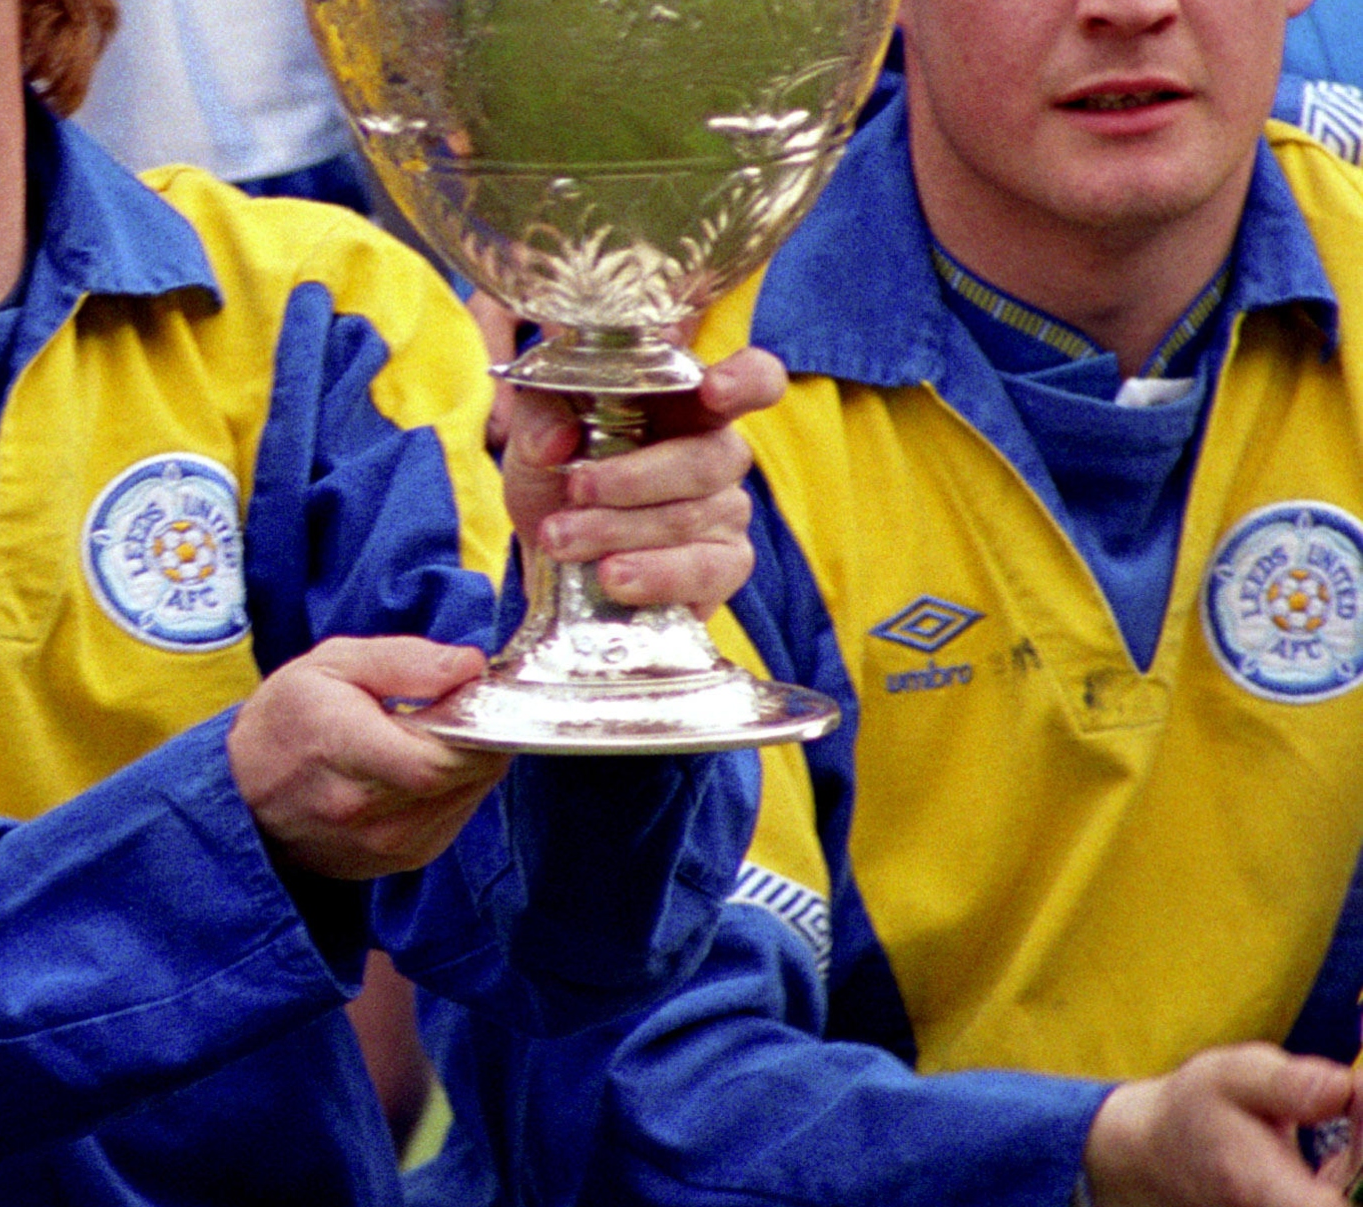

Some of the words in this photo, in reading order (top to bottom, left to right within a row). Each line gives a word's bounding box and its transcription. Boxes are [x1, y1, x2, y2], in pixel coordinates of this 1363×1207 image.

[123, 500, 166, 577] LEEDS
[165, 586, 219, 612] AFC
[1239, 544, 1289, 618] LEEDS
[1307, 544, 1356, 620] UNITED
[1269, 636, 1324, 661] AFC
[885, 658, 974, 694] umbro
